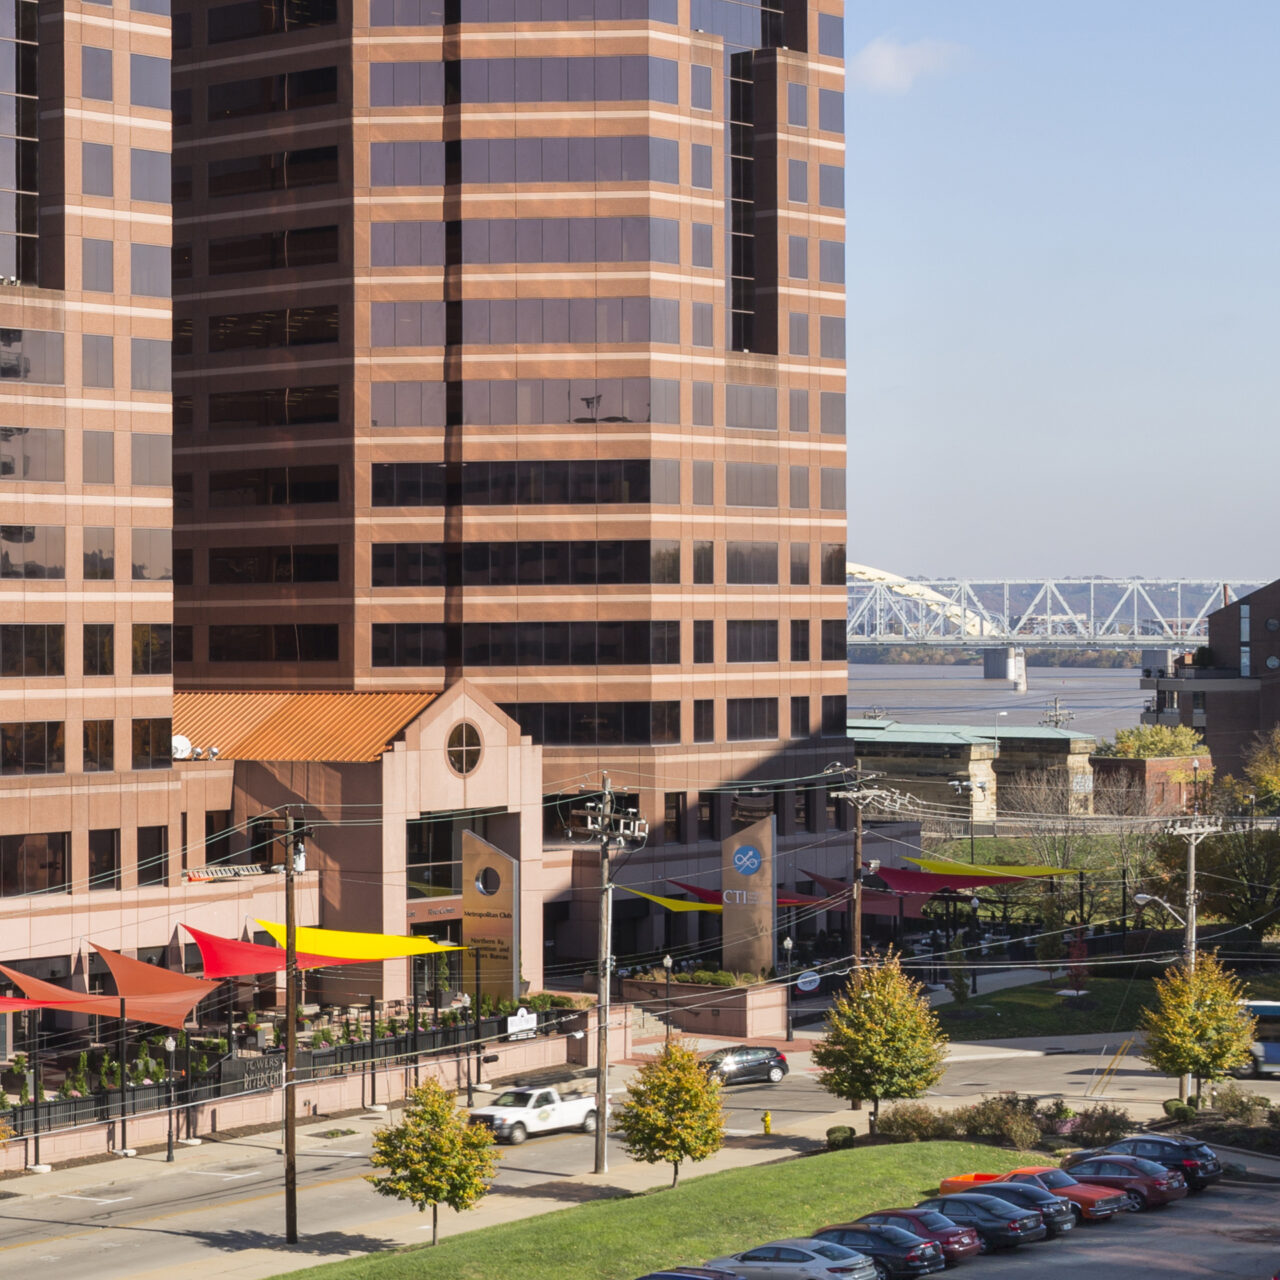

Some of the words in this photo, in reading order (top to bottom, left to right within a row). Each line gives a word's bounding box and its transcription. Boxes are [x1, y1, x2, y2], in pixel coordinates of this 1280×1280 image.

[722, 889, 746, 904] CTI
[464, 910, 498, 919] Metropolitan
[499, 911, 513, 919] Club
[470, 937, 496, 945] Northern
[499, 945, 510, 953] and
[489, 952, 509, 960] Bureau
[246, 1057, 279, 1071] TOWERS
